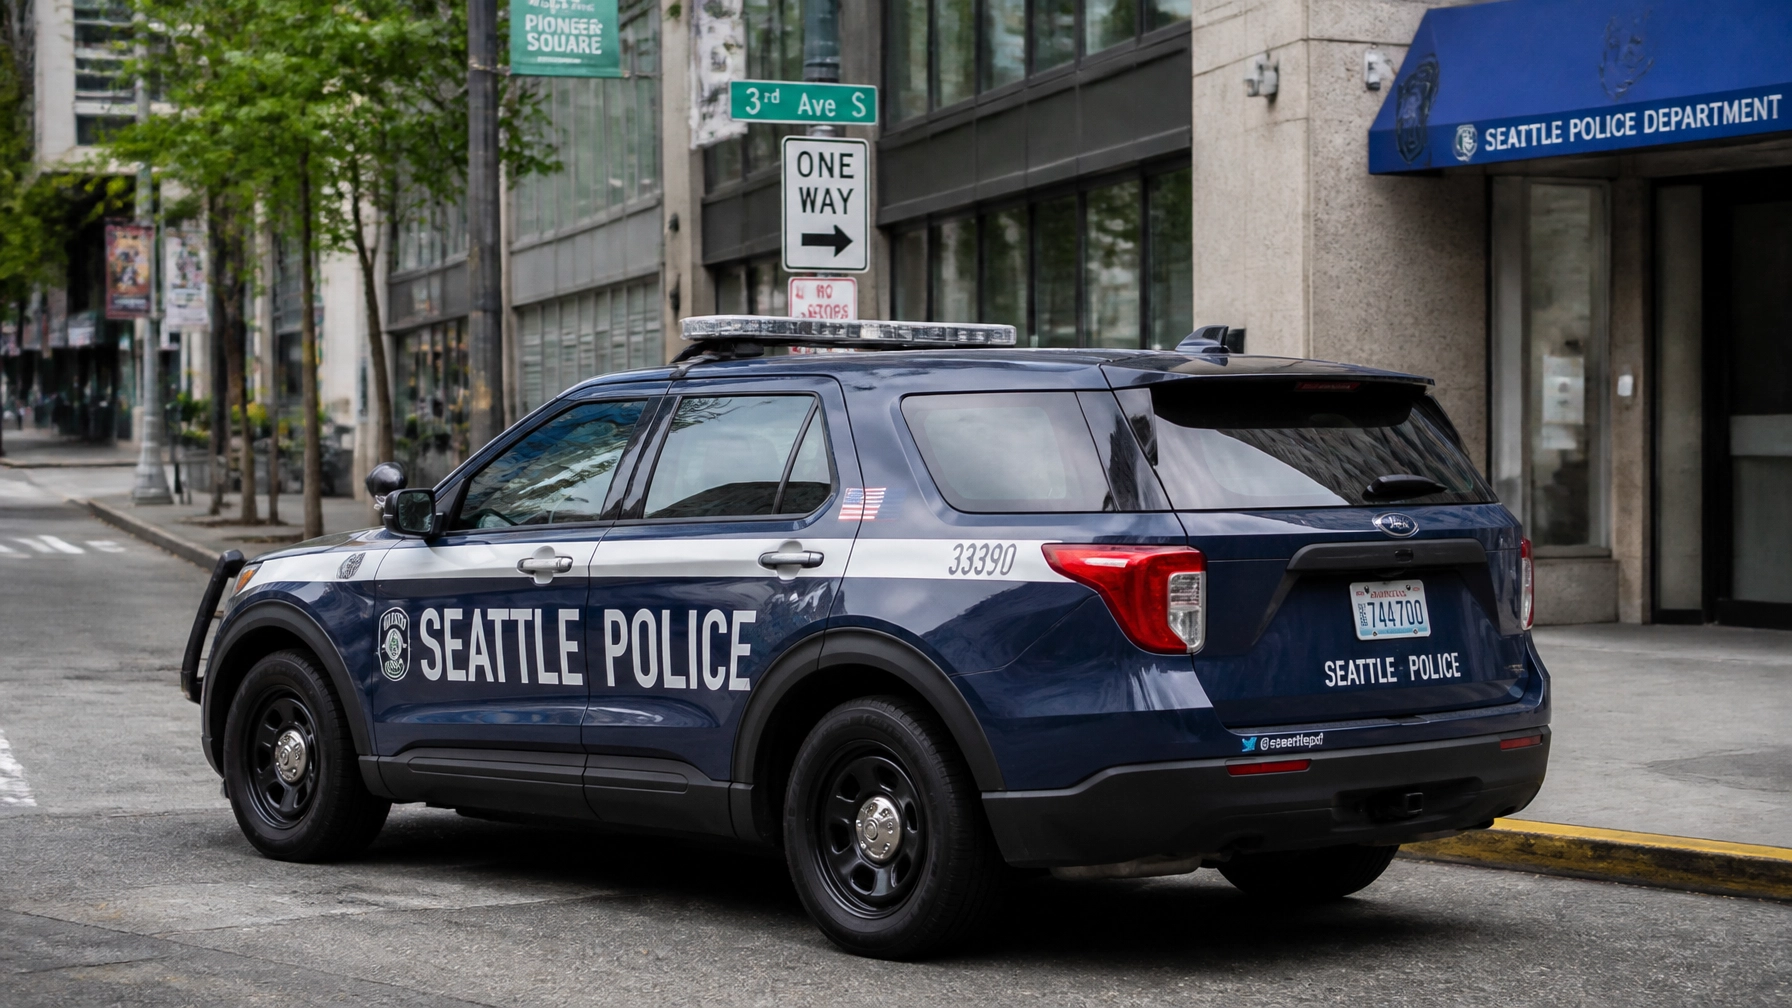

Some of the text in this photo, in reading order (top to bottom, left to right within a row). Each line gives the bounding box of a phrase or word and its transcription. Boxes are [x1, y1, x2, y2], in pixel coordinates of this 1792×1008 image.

[525, 13, 603, 35] PIONEER
[526, 32, 602, 55] SQUARE
[745, 87, 866, 118] 3rd Ave S
[1484, 94, 1782, 151] SEATTLE POLICE DEPARTMENT
[797, 150, 854, 179] ONE
[798, 186, 854, 215] WAY
[948, 542, 1017, 576] 33390
[1367, 600, 1424, 628] 744700
[419, 607, 757, 691] SEATTLE POLICE
[1324, 652, 1461, 687] SEATTLE POLICE
